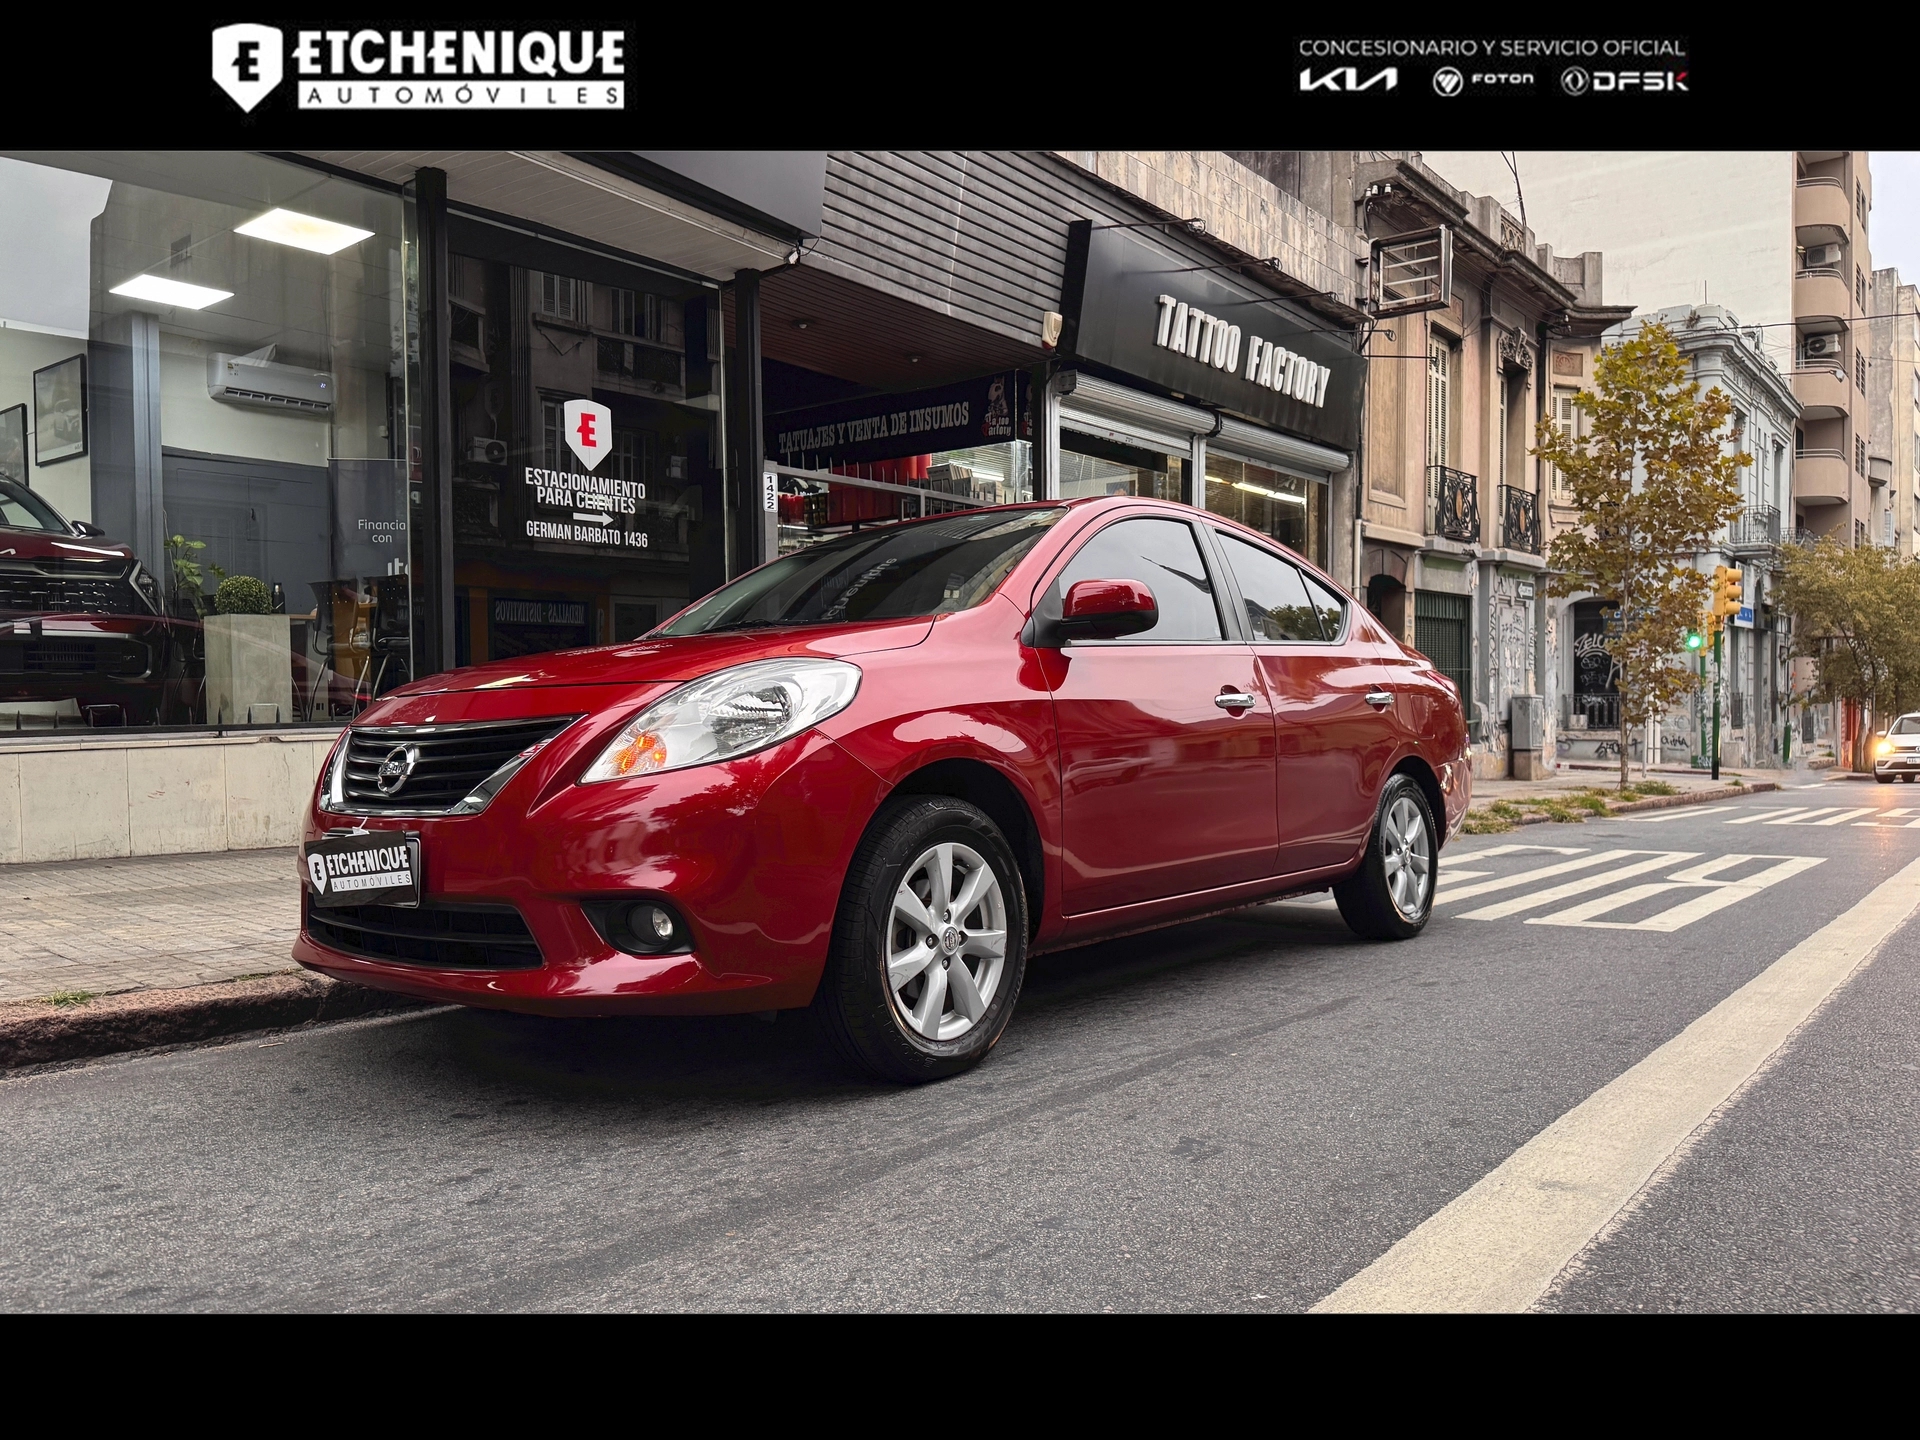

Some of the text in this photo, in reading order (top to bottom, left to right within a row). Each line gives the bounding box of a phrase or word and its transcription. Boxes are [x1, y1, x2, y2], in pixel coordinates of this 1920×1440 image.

[1156, 294, 1331, 409] TATTOO FACTORY
[778, 401, 970, 454] TATUAJES Y VENTA DE INSUMOS
[525, 467, 646, 500] ESTACIONAMIENTO
[766, 475, 775, 510] 1422
[536, 486, 636, 514] PARA CLIENTES
[371, 534, 393, 543] con
[526, 520, 648, 548] GERMAN BARBATO 1436
[326, 845, 410, 877] ETCHENIQUE
[333, 873, 412, 891] AUTOMÓVILES
